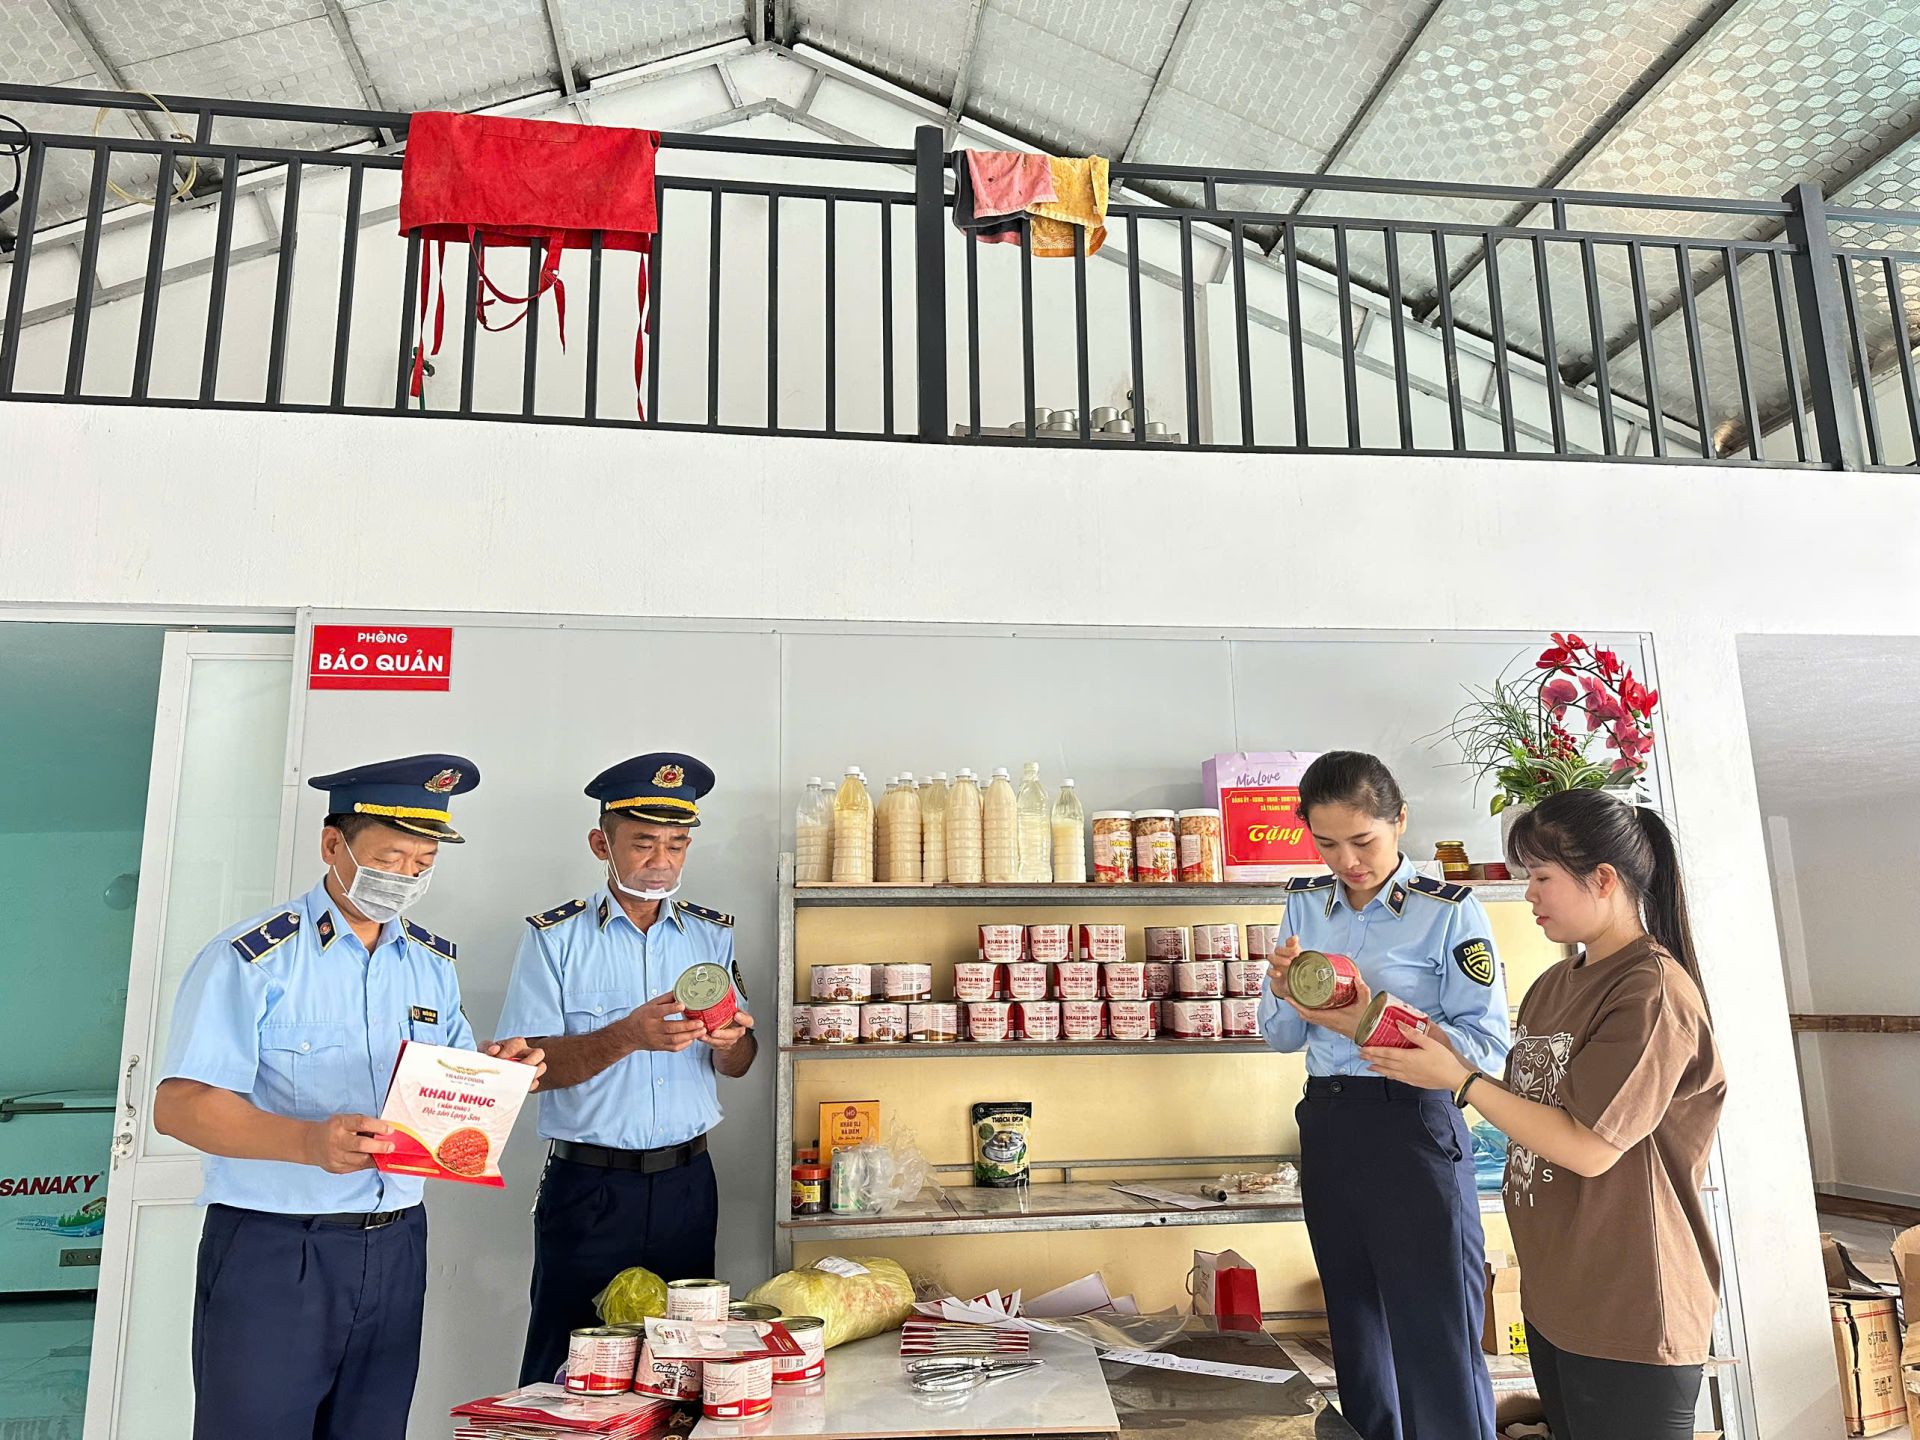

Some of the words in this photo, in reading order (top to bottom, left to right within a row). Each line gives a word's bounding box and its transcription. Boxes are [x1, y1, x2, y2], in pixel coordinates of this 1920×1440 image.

[357, 630, 408, 643] PHÒNG
[318, 647, 369, 671] BẢO
[375, 648, 443, 672] QUẢN
[1248, 824, 1304, 845] Tặng
[1463, 942, 1485, 956] DMS
[419, 1087, 457, 1101] KHAU
[458, 1093, 496, 1109] NHỤC
[0, 1174, 100, 1197] SANAKY
